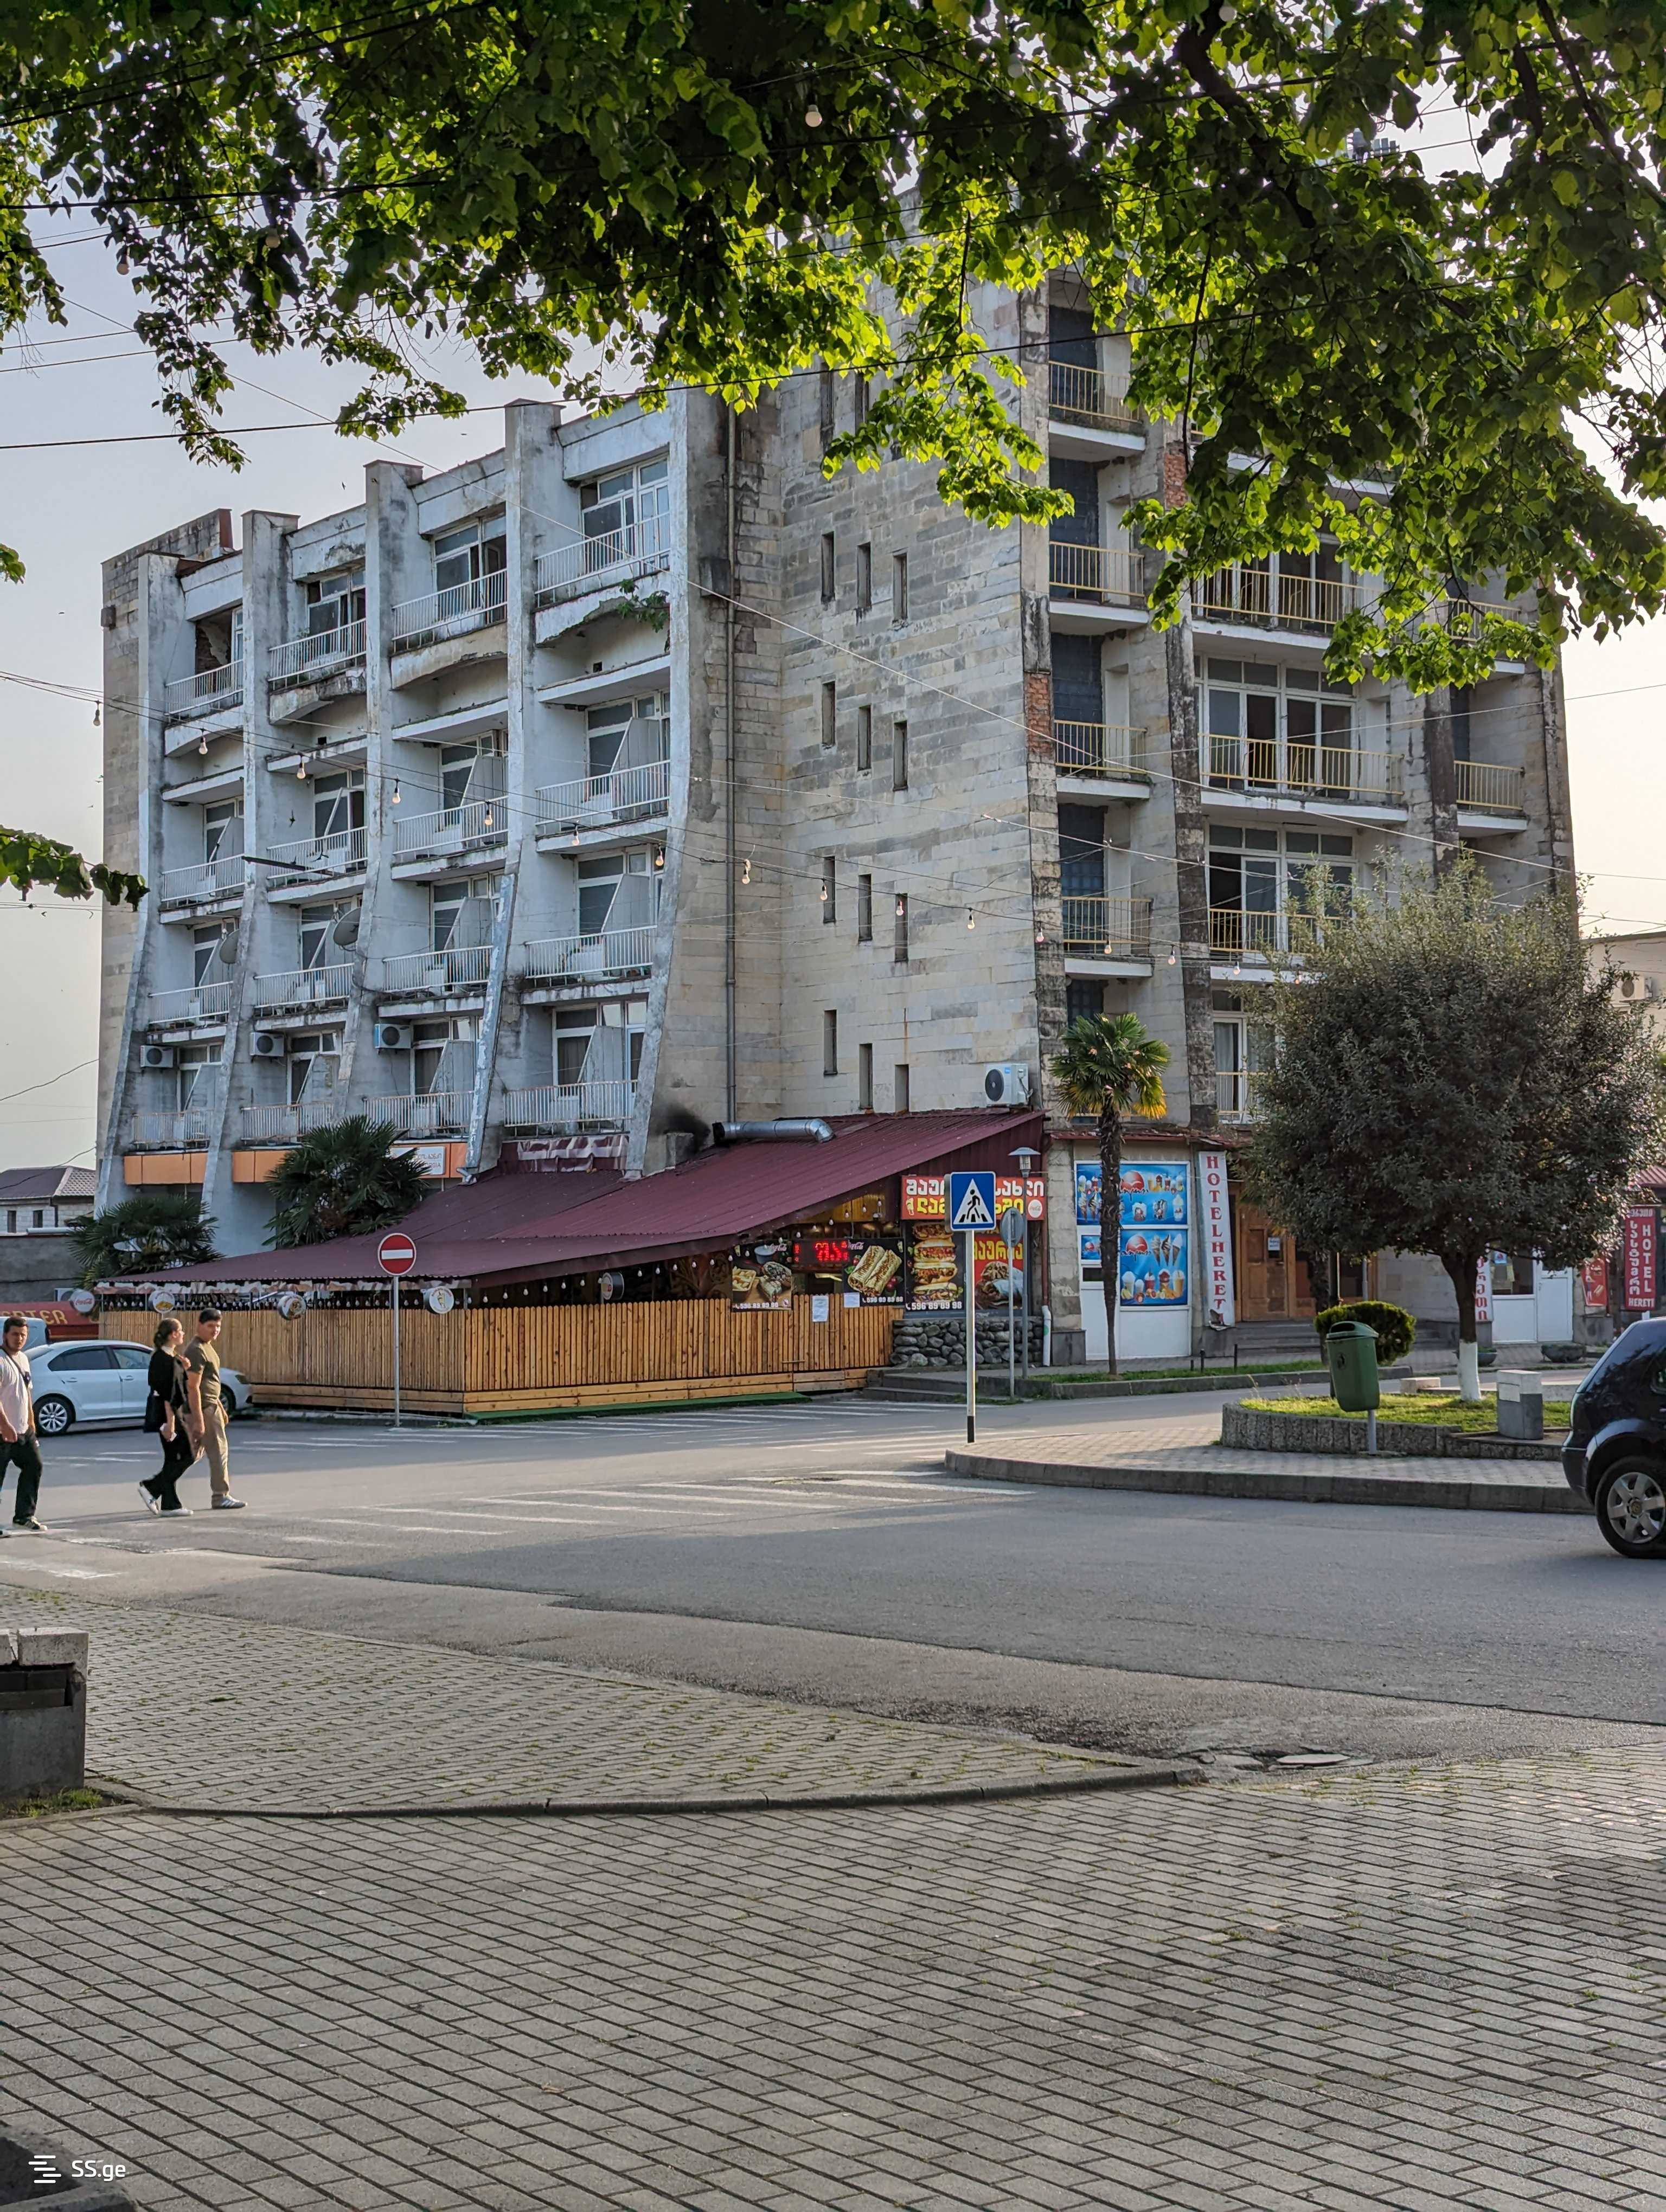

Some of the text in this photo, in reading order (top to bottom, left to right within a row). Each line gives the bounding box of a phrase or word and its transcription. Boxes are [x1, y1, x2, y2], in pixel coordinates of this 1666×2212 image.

[1206, 1156, 1223, 1237] HOTEL
[1642, 1225, 1652, 1293] HOTEL
[912, 1302, 926, 1310] 596
[928, 1302, 938, 1310] 89
[952, 1301, 962, 1309] 98
[1629, 1298, 1654, 1307] HERETI
